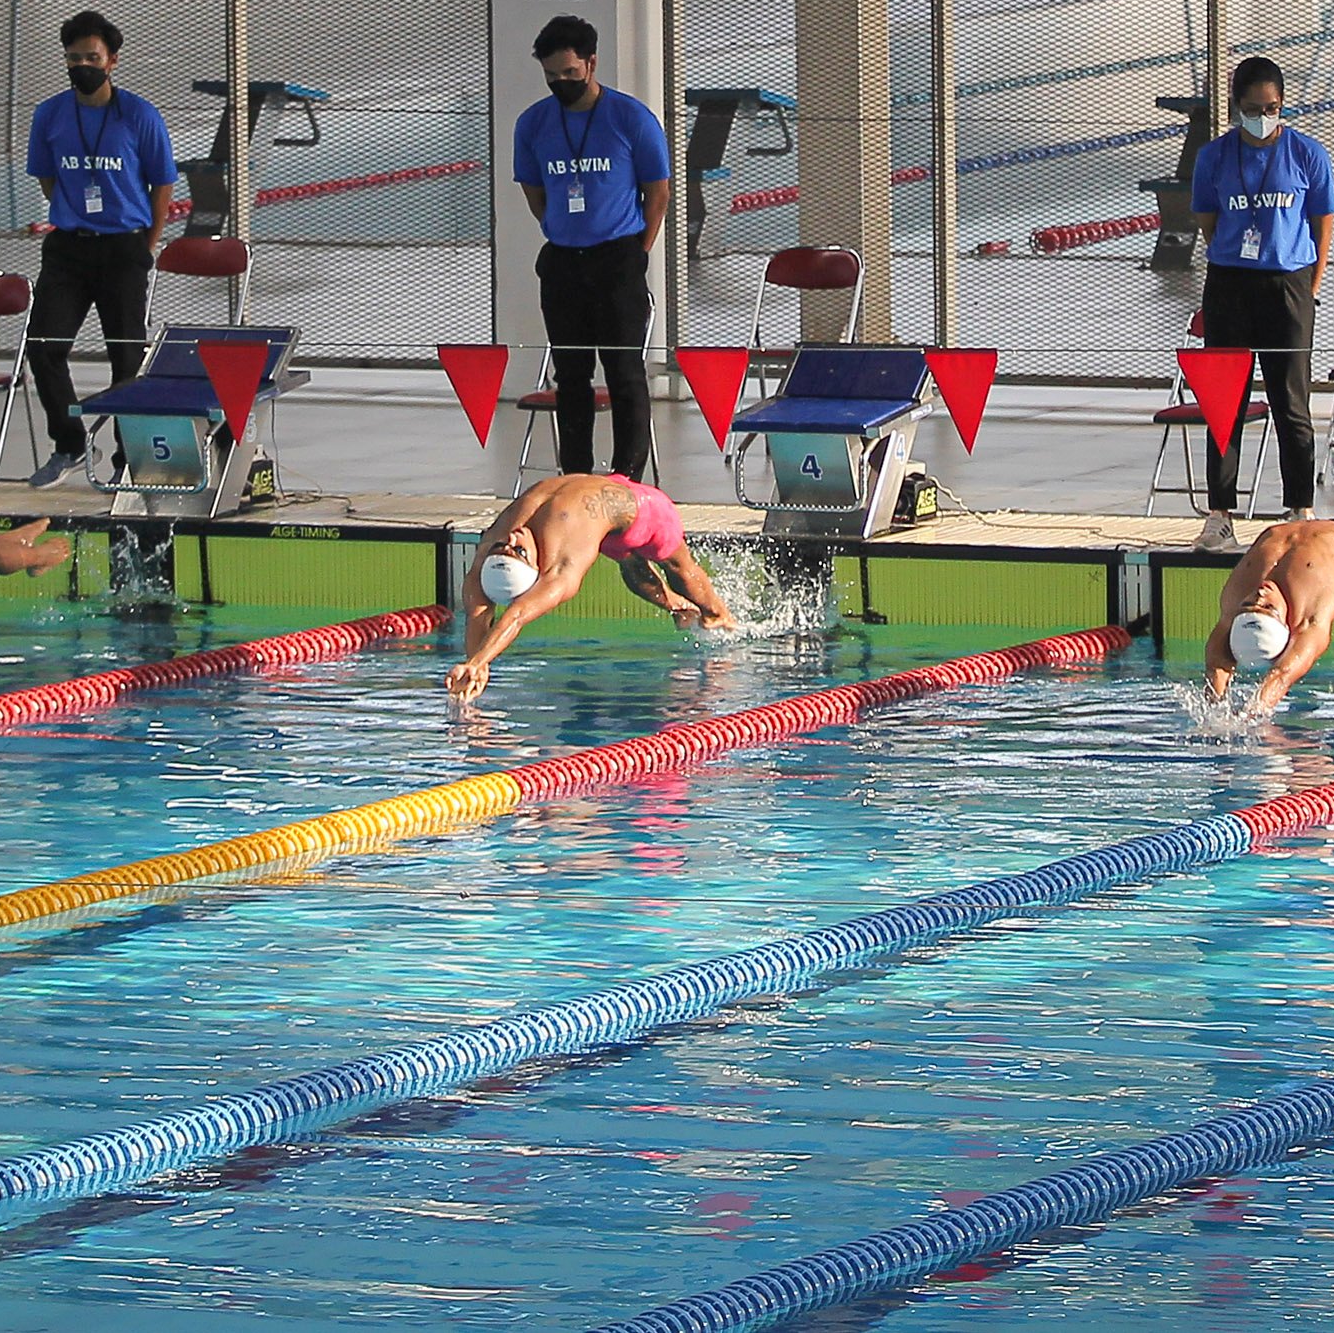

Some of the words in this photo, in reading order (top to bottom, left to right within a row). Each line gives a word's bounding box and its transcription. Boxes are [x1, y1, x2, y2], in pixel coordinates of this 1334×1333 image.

[61, 156, 79, 169] AB
[84, 156, 122, 171] SWIM
[547, 160, 567, 175] AB
[570, 157, 611, 173] SWIM
[1229, 195, 1248, 210] AB
[1253, 192, 1295, 208] SWIM
[151, 435, 172, 462] 5
[800, 453, 823, 480] 4
